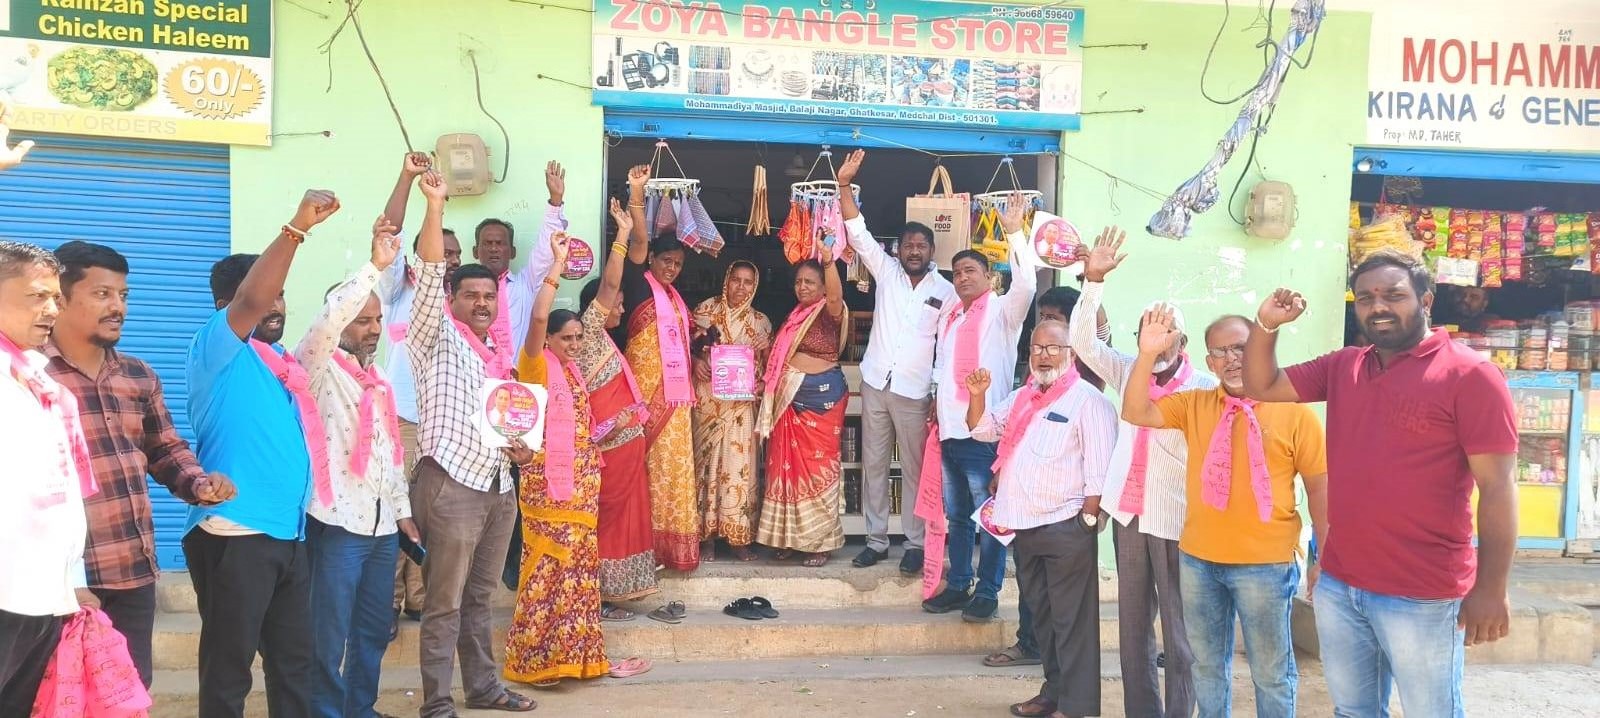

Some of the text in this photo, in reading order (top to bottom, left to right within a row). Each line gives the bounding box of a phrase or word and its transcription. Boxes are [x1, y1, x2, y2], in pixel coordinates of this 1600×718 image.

[153, 0, 248, 23] Special
[1045, 9, 1074, 20] 59640
[38, 14, 249, 50] Chicken Haleem
[610, 0, 1069, 55] ZOYA BANGLE STORE
[1402, 37, 1600, 89] MOHAMM
[181, 65, 253, 97] 60/-
[194, 97, 235, 114] Only
[686, 99, 752, 112] Mohammadiya
[754, 103, 787, 114] Masjid,
[789, 105, 816, 116] Balaji
[818, 106, 847, 117] Nagar,
[850, 108, 897, 119] Ghatkesar,
[899, 110, 936, 121] Medchal
[938, 113, 956, 122] Dist
[1367, 90, 1478, 122] KIRANA
[1522, 96, 1600, 127] GENE
[83, 115, 177, 135] ORDERS
[1430, 129, 1462, 144] TAHER
